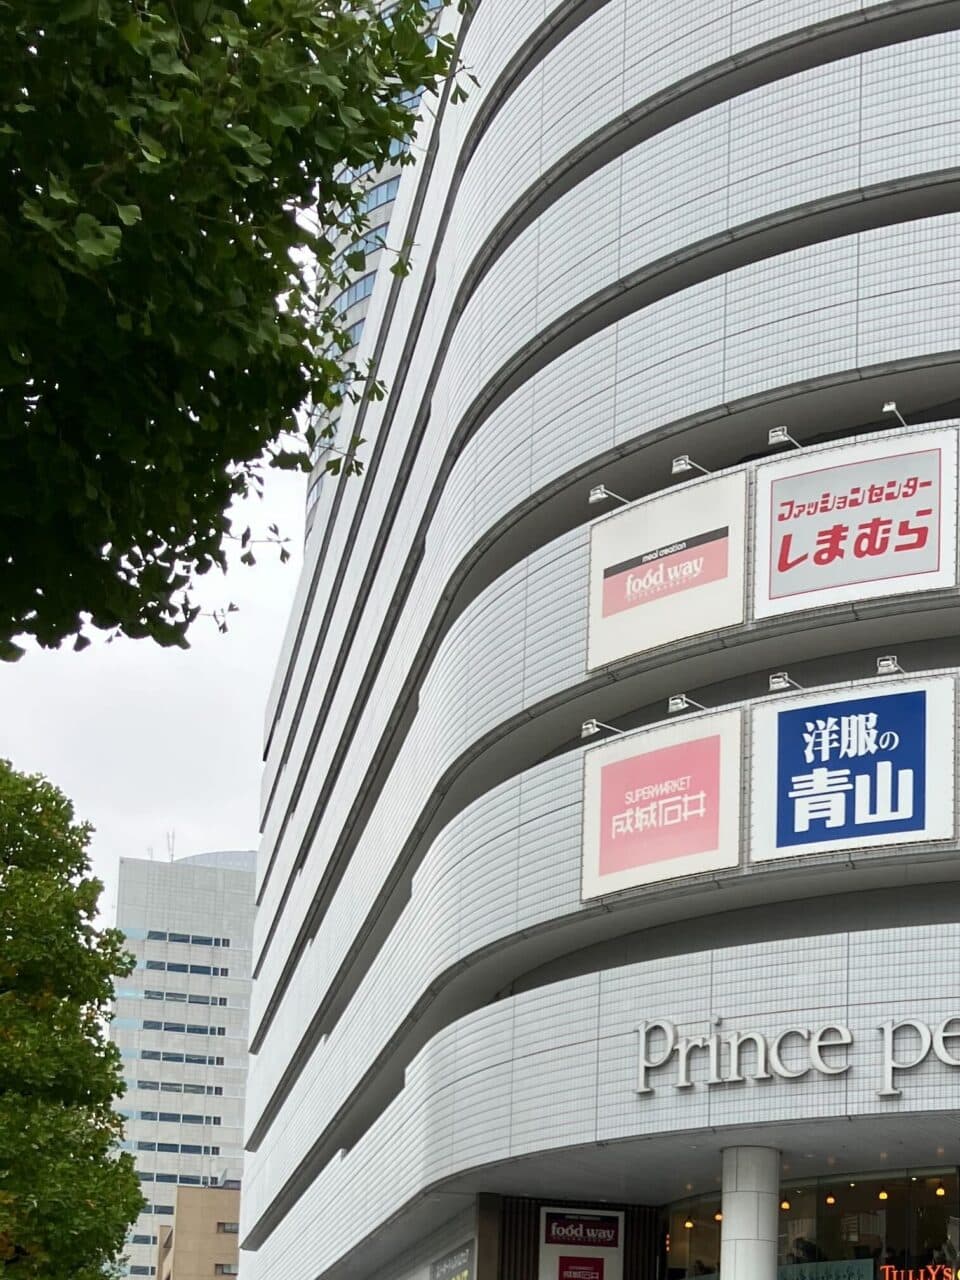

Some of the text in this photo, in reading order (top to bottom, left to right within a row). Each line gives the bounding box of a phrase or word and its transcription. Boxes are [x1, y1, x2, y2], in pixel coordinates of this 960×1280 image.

[777, 476, 933, 522] ファッションセンター
[777, 508, 933, 573] しまむら
[625, 562, 664, 596] food
[667, 556, 705, 581] way
[802, 712, 900, 764] 洋服の
[611, 789, 707, 840] 成城石井
[624, 775, 692, 806] SUPERMARKET
[788, 760, 914, 833] 青山
[635, 1012, 854, 1095] Prince
[551, 1222, 615, 1242] food way
